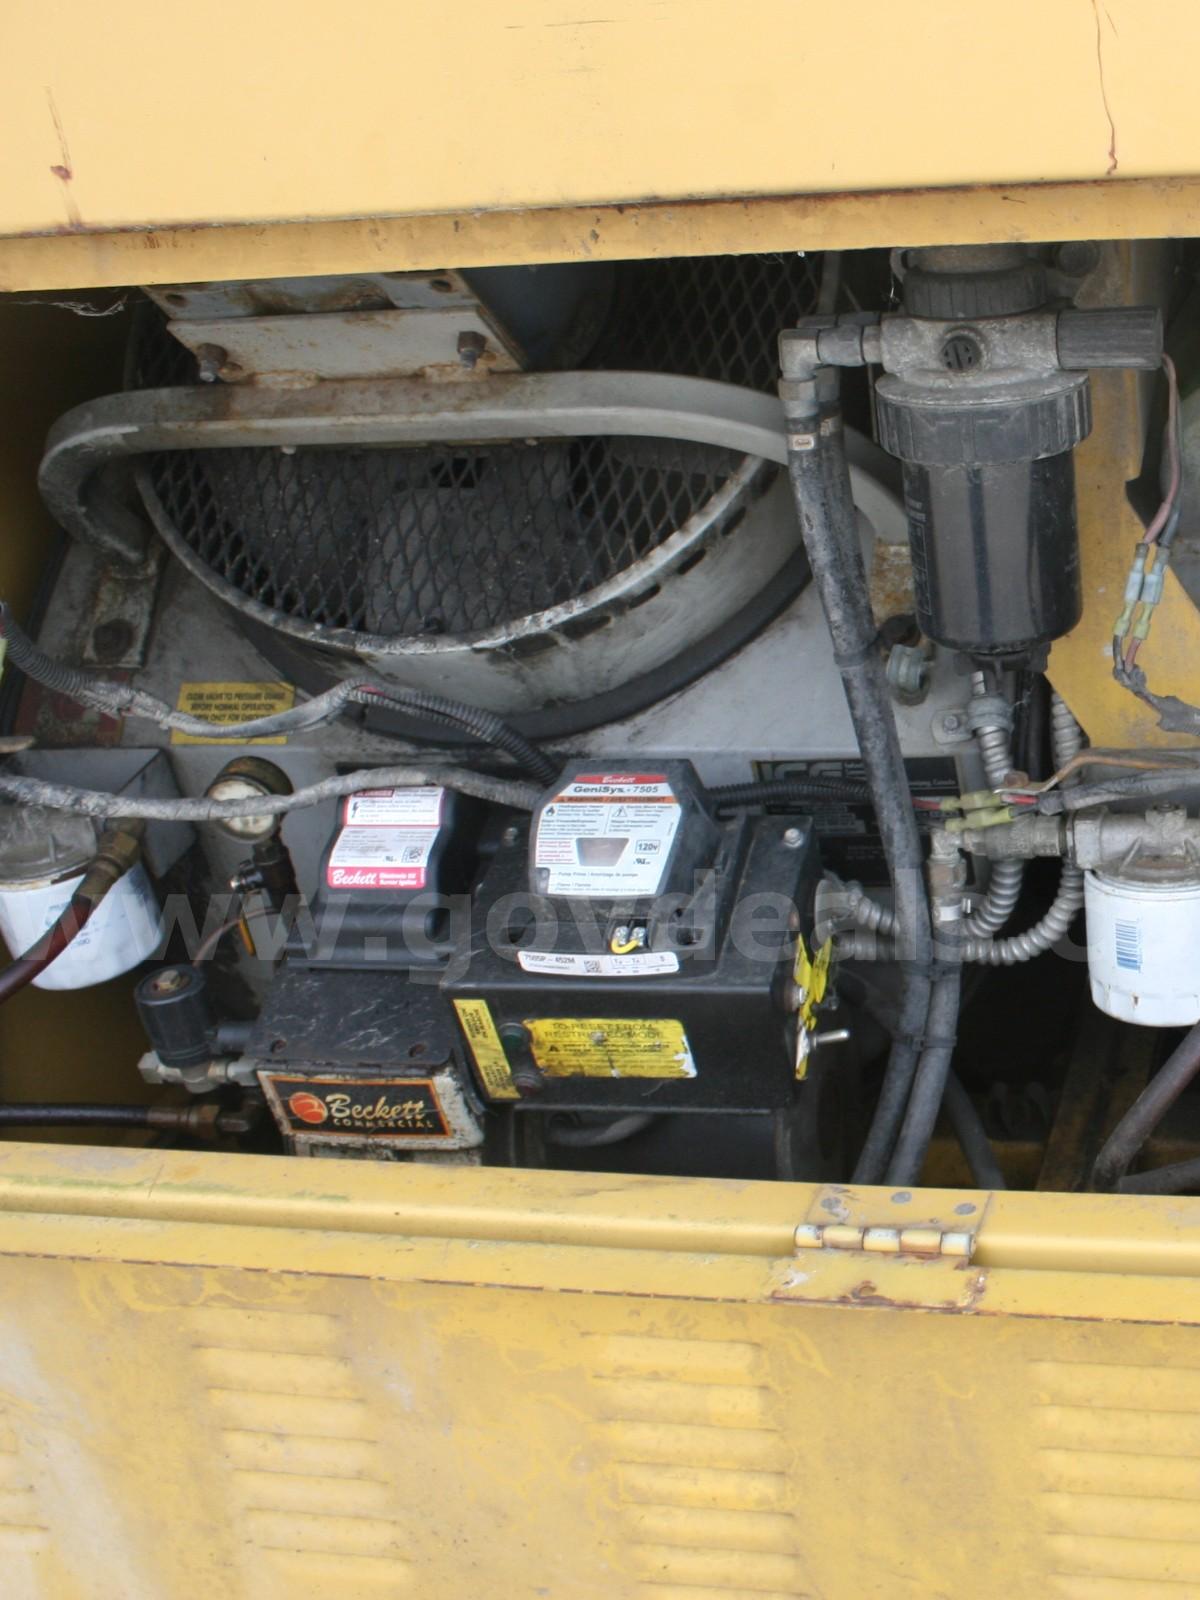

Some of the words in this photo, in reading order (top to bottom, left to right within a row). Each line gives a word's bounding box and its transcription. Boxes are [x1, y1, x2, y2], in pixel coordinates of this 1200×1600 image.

[332, 868, 377, 885] Beckett
[325, 1093, 425, 1120] Beckett
[333, 1119, 434, 1128] COMMERCIAL
